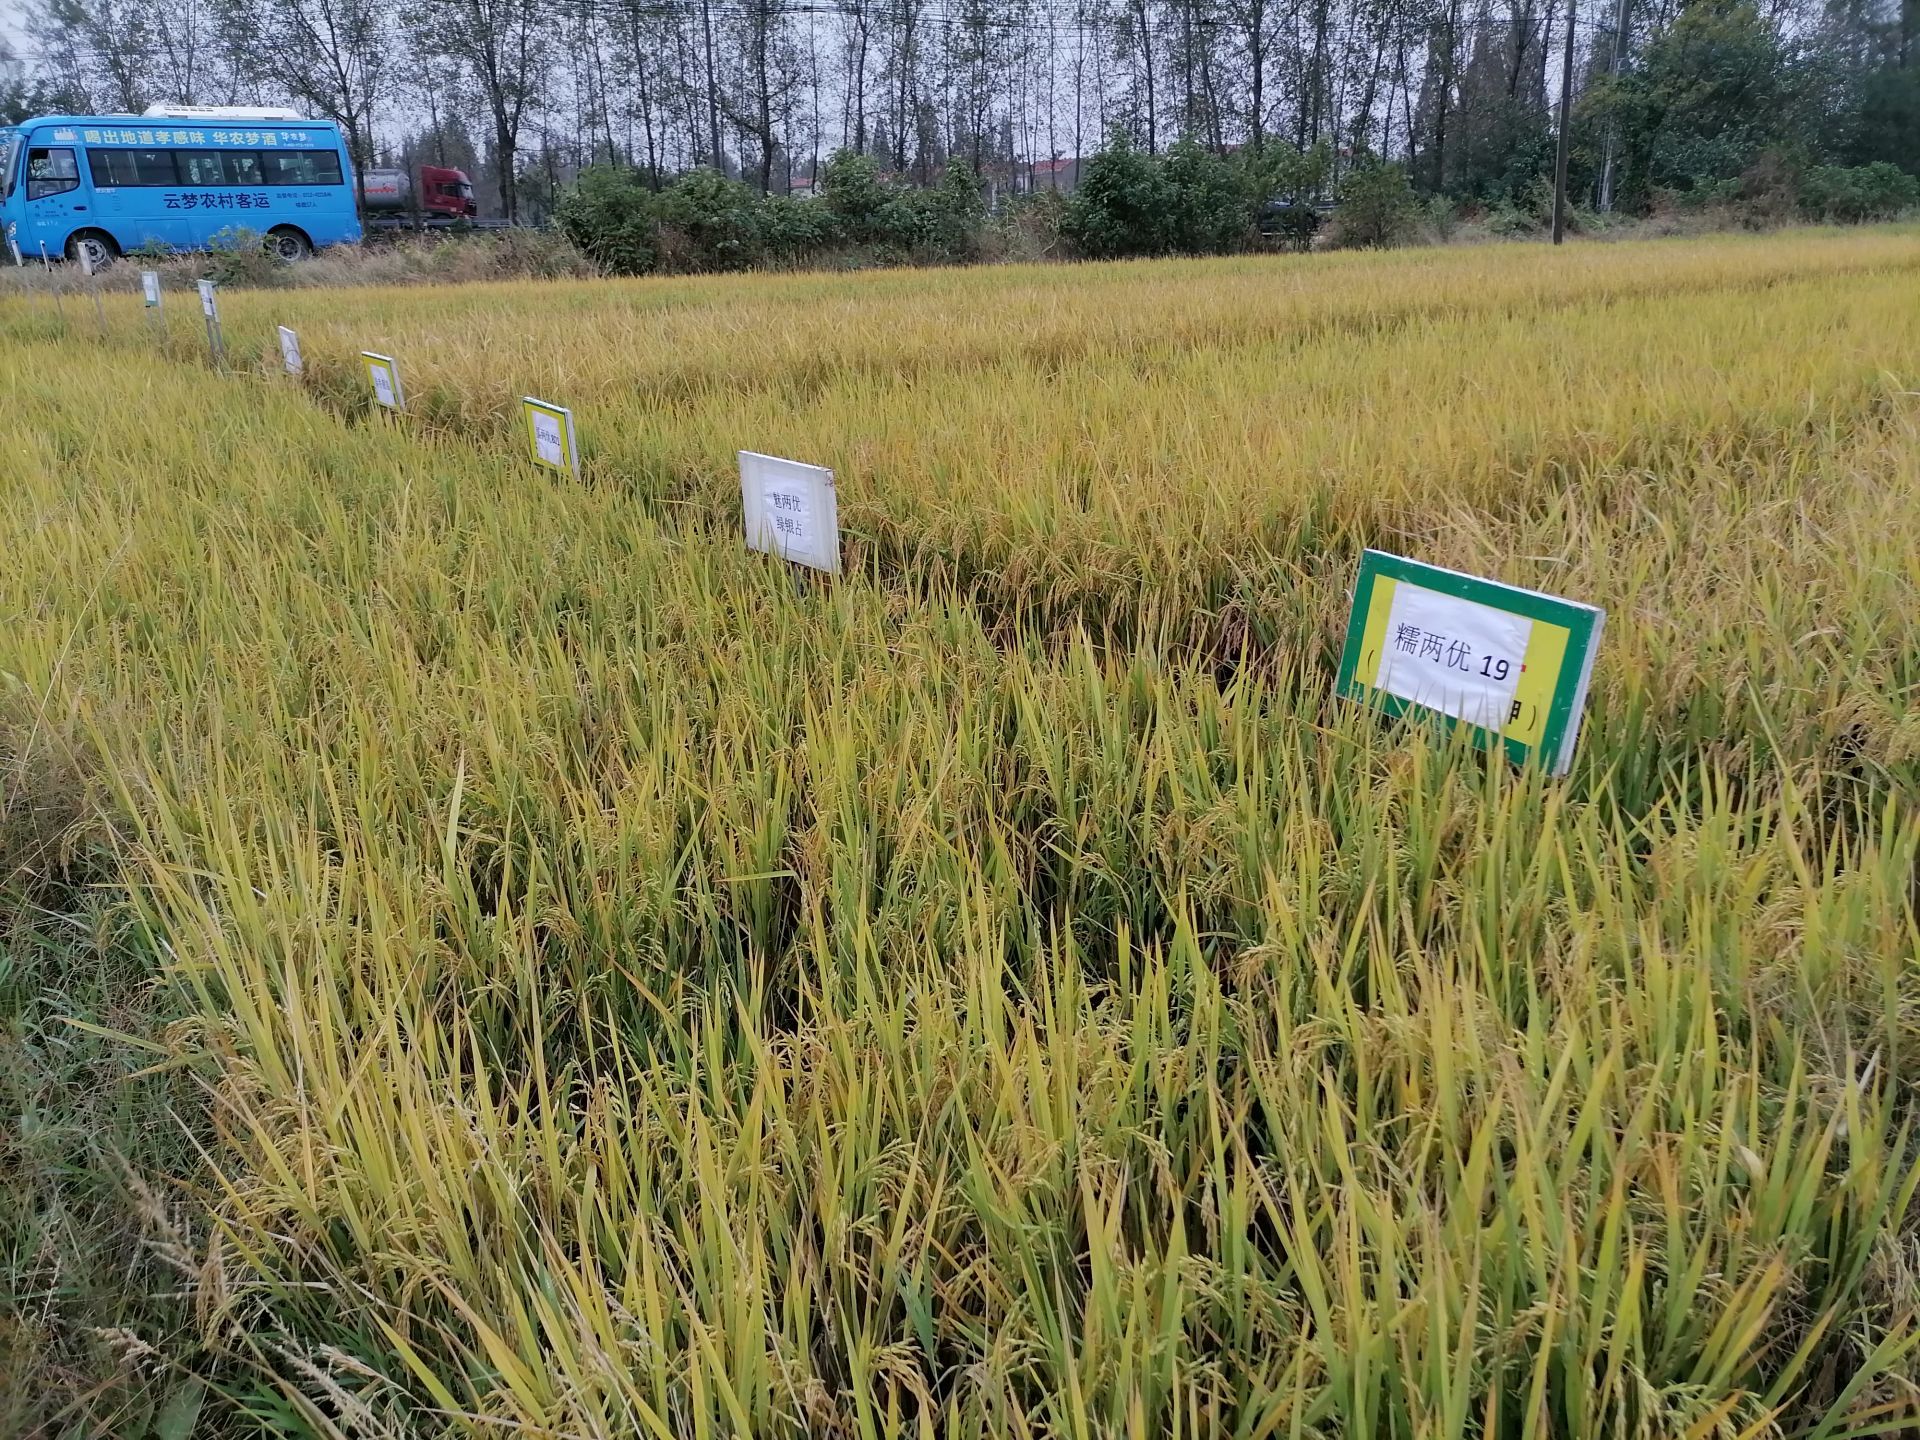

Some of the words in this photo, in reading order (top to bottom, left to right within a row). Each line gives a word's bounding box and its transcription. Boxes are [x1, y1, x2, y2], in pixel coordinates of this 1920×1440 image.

[84, 130, 206, 145] 喝出地道孝感味
[212, 131, 278, 146] 华农梦酒
[163, 192, 270, 209] 云梦农村客运
[1394, 622, 1471, 672] 糯两优
[1480, 655, 1510, 681] 19
